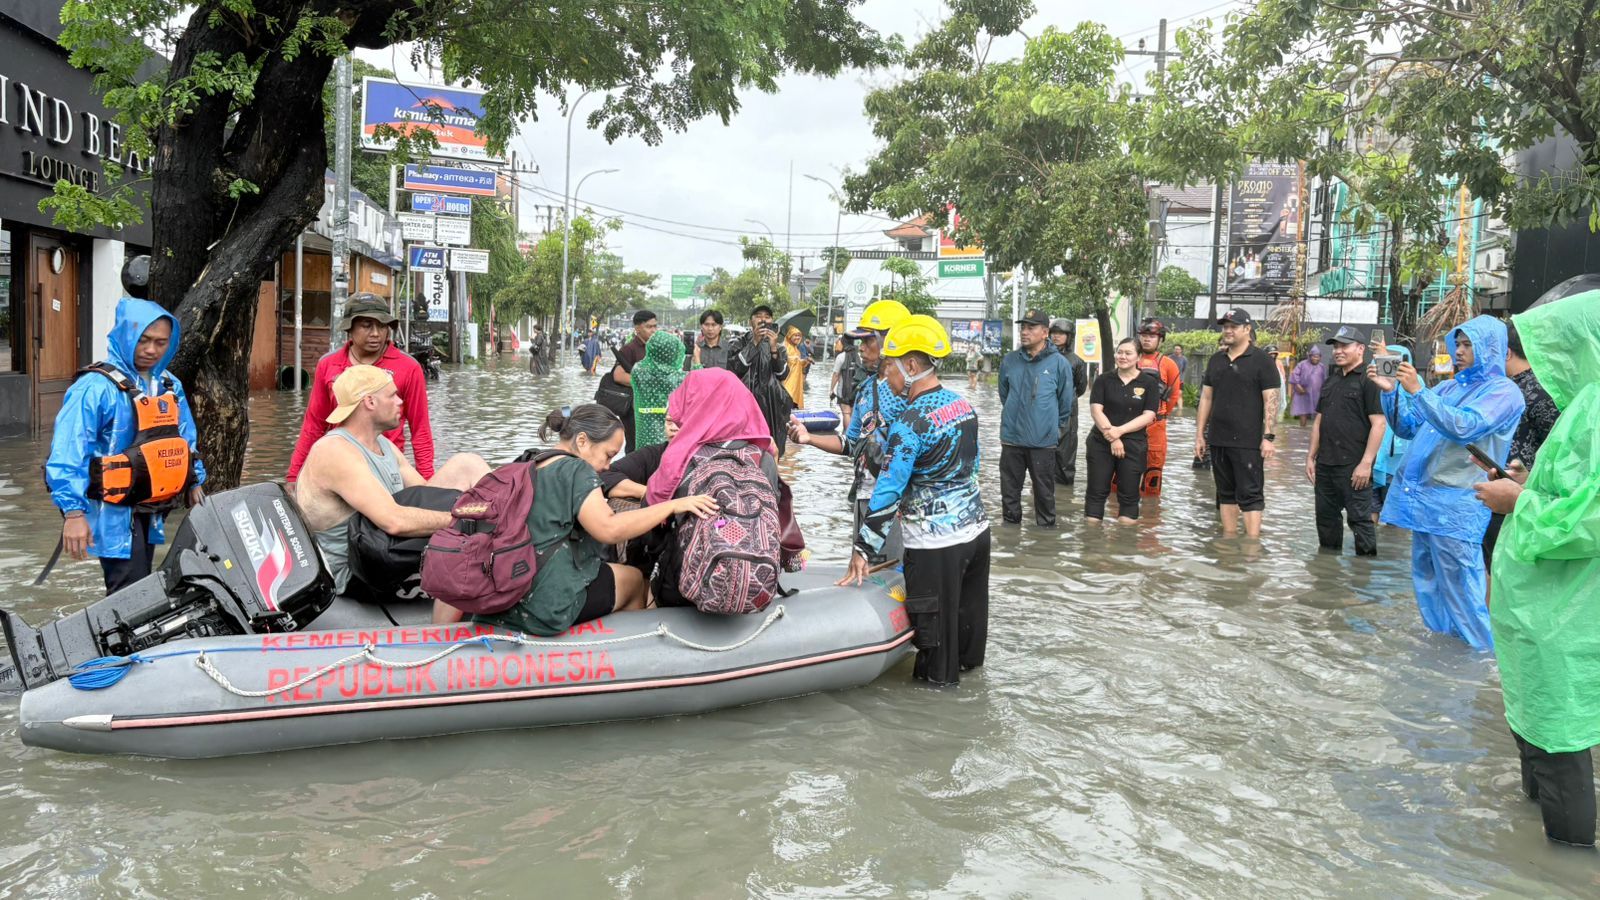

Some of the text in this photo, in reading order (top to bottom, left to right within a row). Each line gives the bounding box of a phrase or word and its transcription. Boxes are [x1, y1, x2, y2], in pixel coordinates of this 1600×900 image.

[434, 113, 477, 127] arma
[87, 112, 155, 175] BEA
[30, 151, 100, 192] LOUNGE
[1238, 180, 1273, 191] PROMO
[415, 195, 469, 212] OPEN 24 HOURS
[234, 509, 265, 561] SUZUKI
[271, 498, 310, 568] KEMENTERIAN SOSIAL RI
[261, 624, 495, 655] KEMENTERIAN
[266, 650, 617, 703] REPUBLIK INDONESIA
